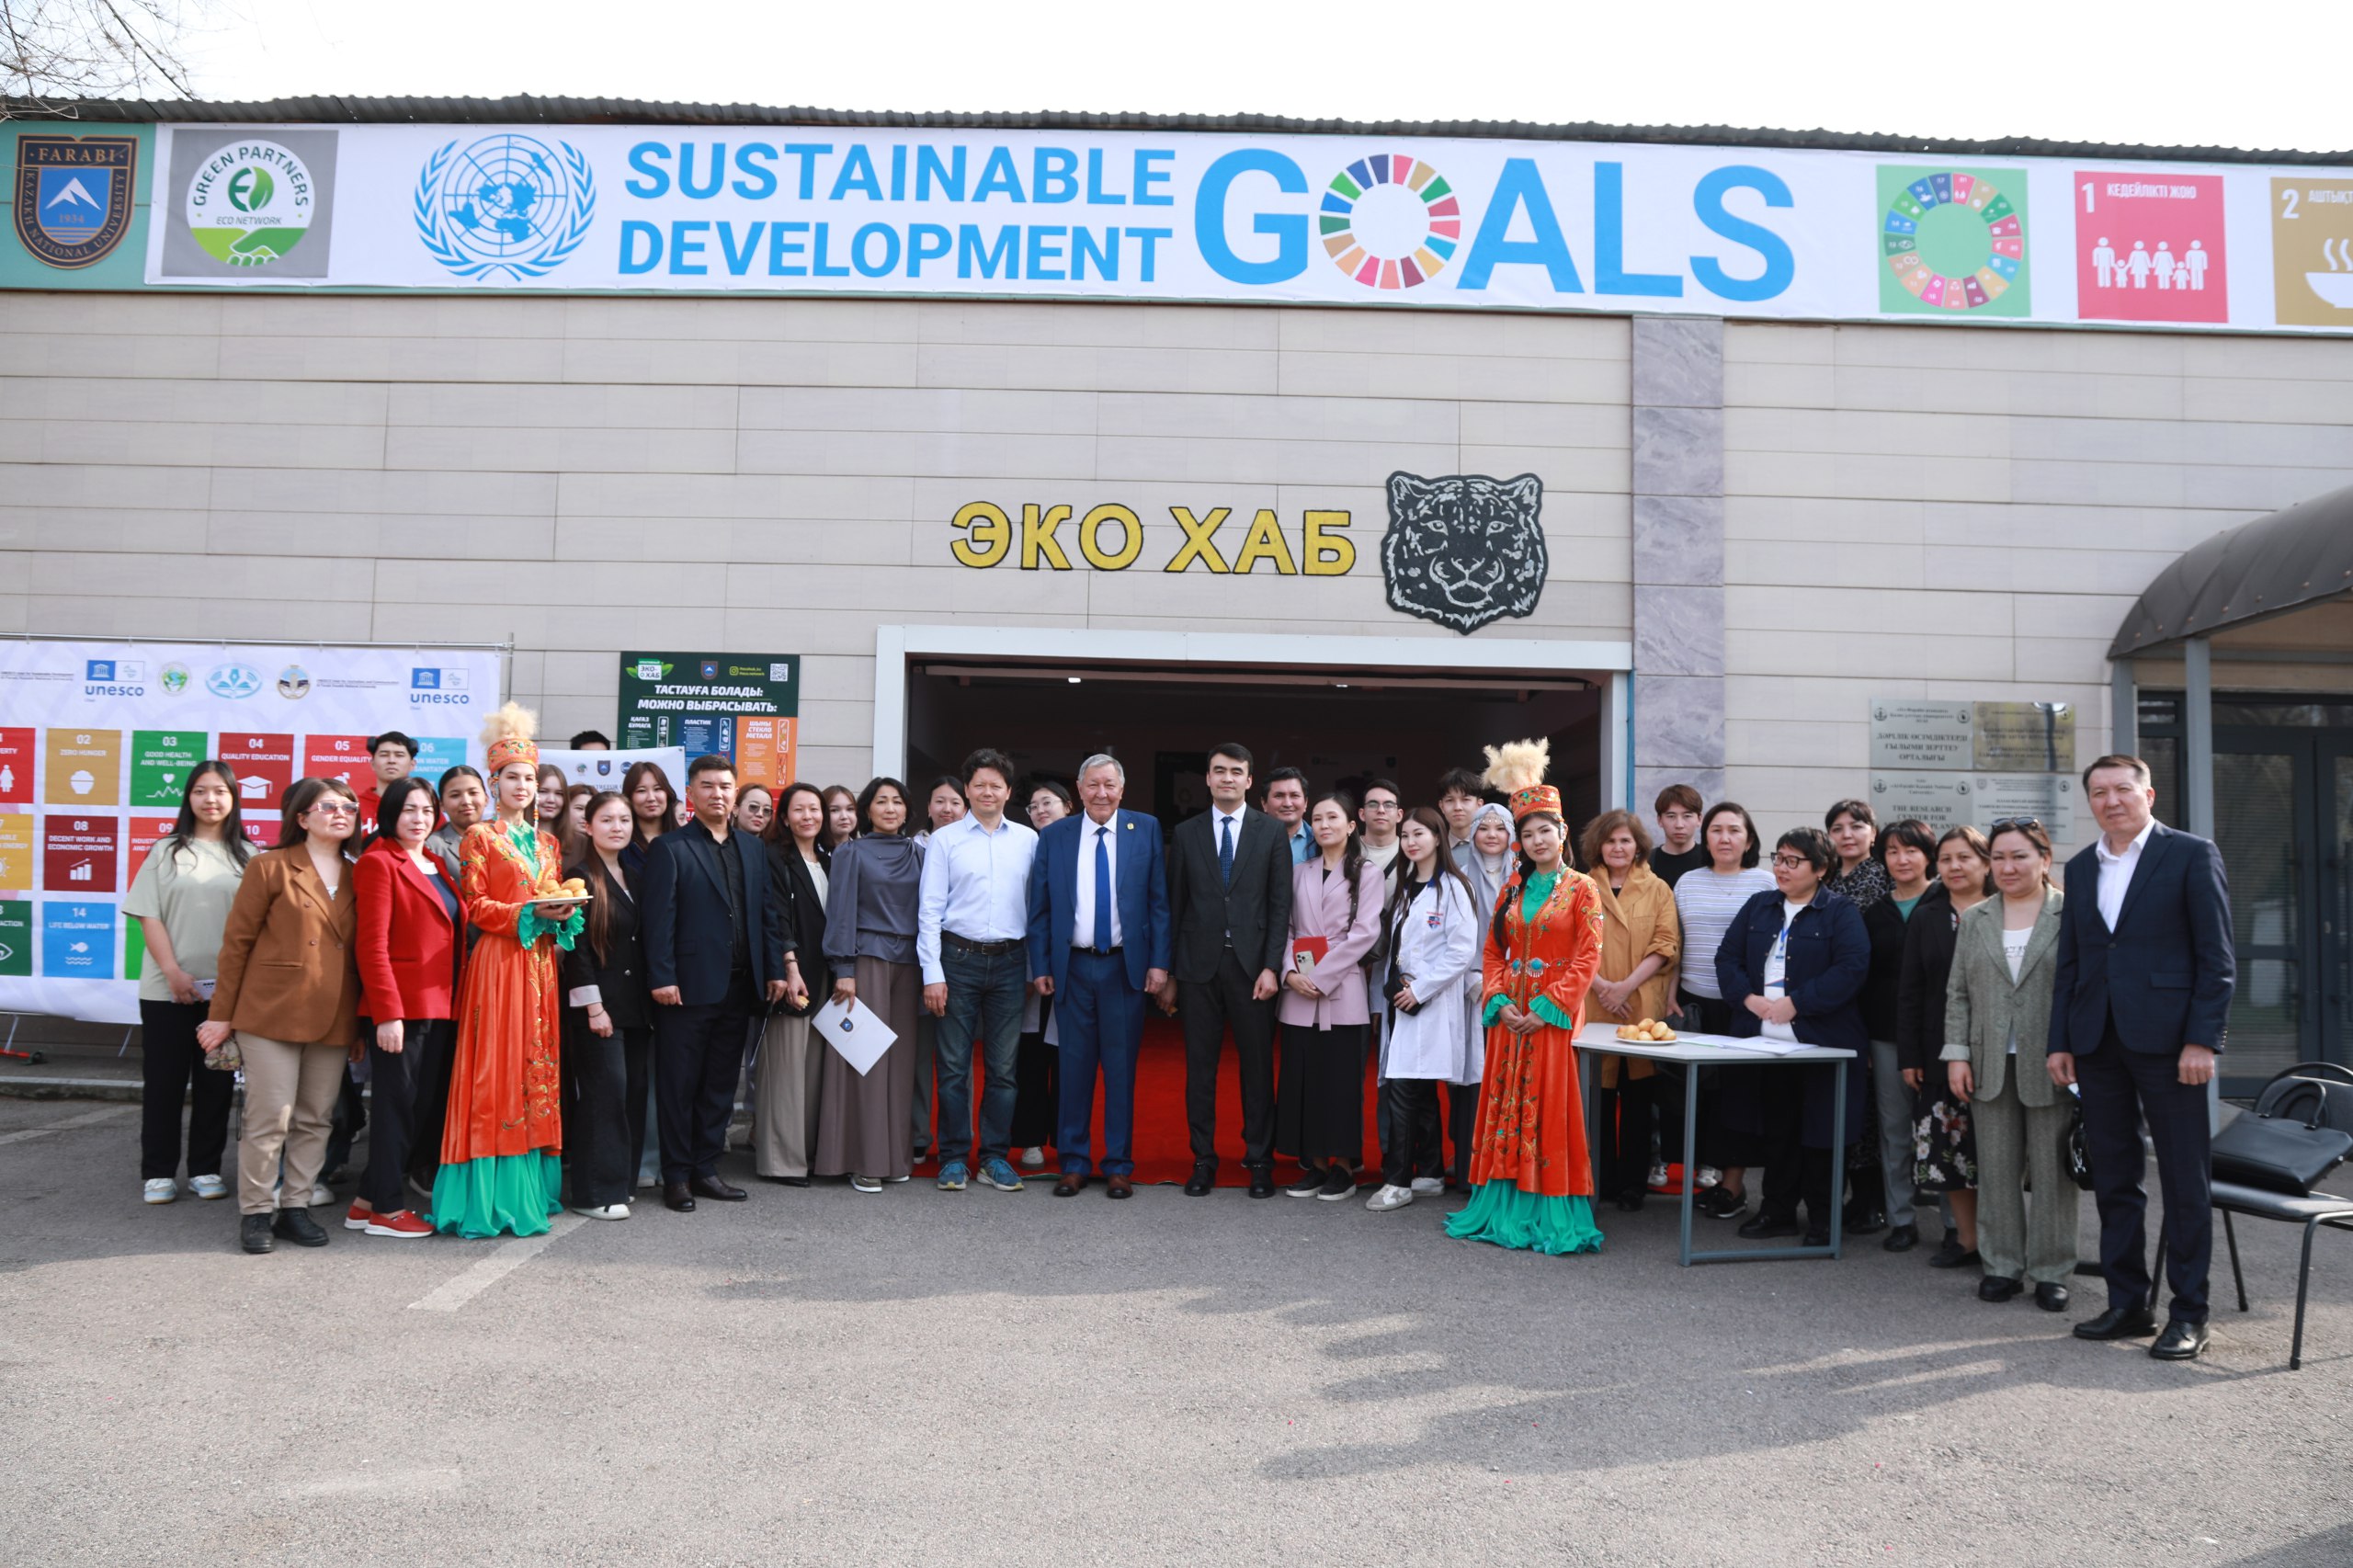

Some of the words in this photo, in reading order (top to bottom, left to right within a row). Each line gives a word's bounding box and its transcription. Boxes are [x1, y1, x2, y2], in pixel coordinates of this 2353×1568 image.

[39, 148, 116, 163] FARABI
[193, 152, 234, 207] GREEN
[238, 146, 309, 207] PARTNERS
[625, 141, 1176, 206] SUSTAINABLE
[24, 172, 36, 225] KAZAKH
[2082, 182, 2095, 213] 1
[2169, 185, 2197, 199] ЖОЮ
[2308, 189, 2353, 205] АШТЫҚТ
[2281, 188, 2300, 219] 2
[94, 174, 126, 248] UNIVERSITY
[59, 214, 85, 223] 1934
[216, 216, 235, 225] ECO
[235, 216, 282, 225] NETWORK
[1195, 147, 1795, 302] GOALS
[29, 228, 92, 257] NATIONAL
[618, 219, 1174, 282] DEVELOPMENT
[949, 501, 1144, 571] ЭКО
[1164, 506, 1356, 576] ХАБ
[85, 685, 144, 697] unesco
[654, 685, 709, 696] ТАСТАУҒА
[710, 686, 764, 698] БОЛАДЫ:
[410, 693, 470, 704] unesco
[637, 699, 685, 710] МОЖНО
[686, 700, 778, 712] ВЫБРАСЫВАТЬ:
[76, 734, 91, 744] 02
[162, 736, 177, 746] 03
[248, 738, 264, 749] 04
[335, 741, 350, 751] 05
[420, 742, 435, 753] 06
[221, 753, 250, 761] QUALITY
[74, 821, 89, 831] 08
[158, 823, 174, 834] 09
[245, 824, 260, 835] 10
[73, 907, 87, 917] 14
